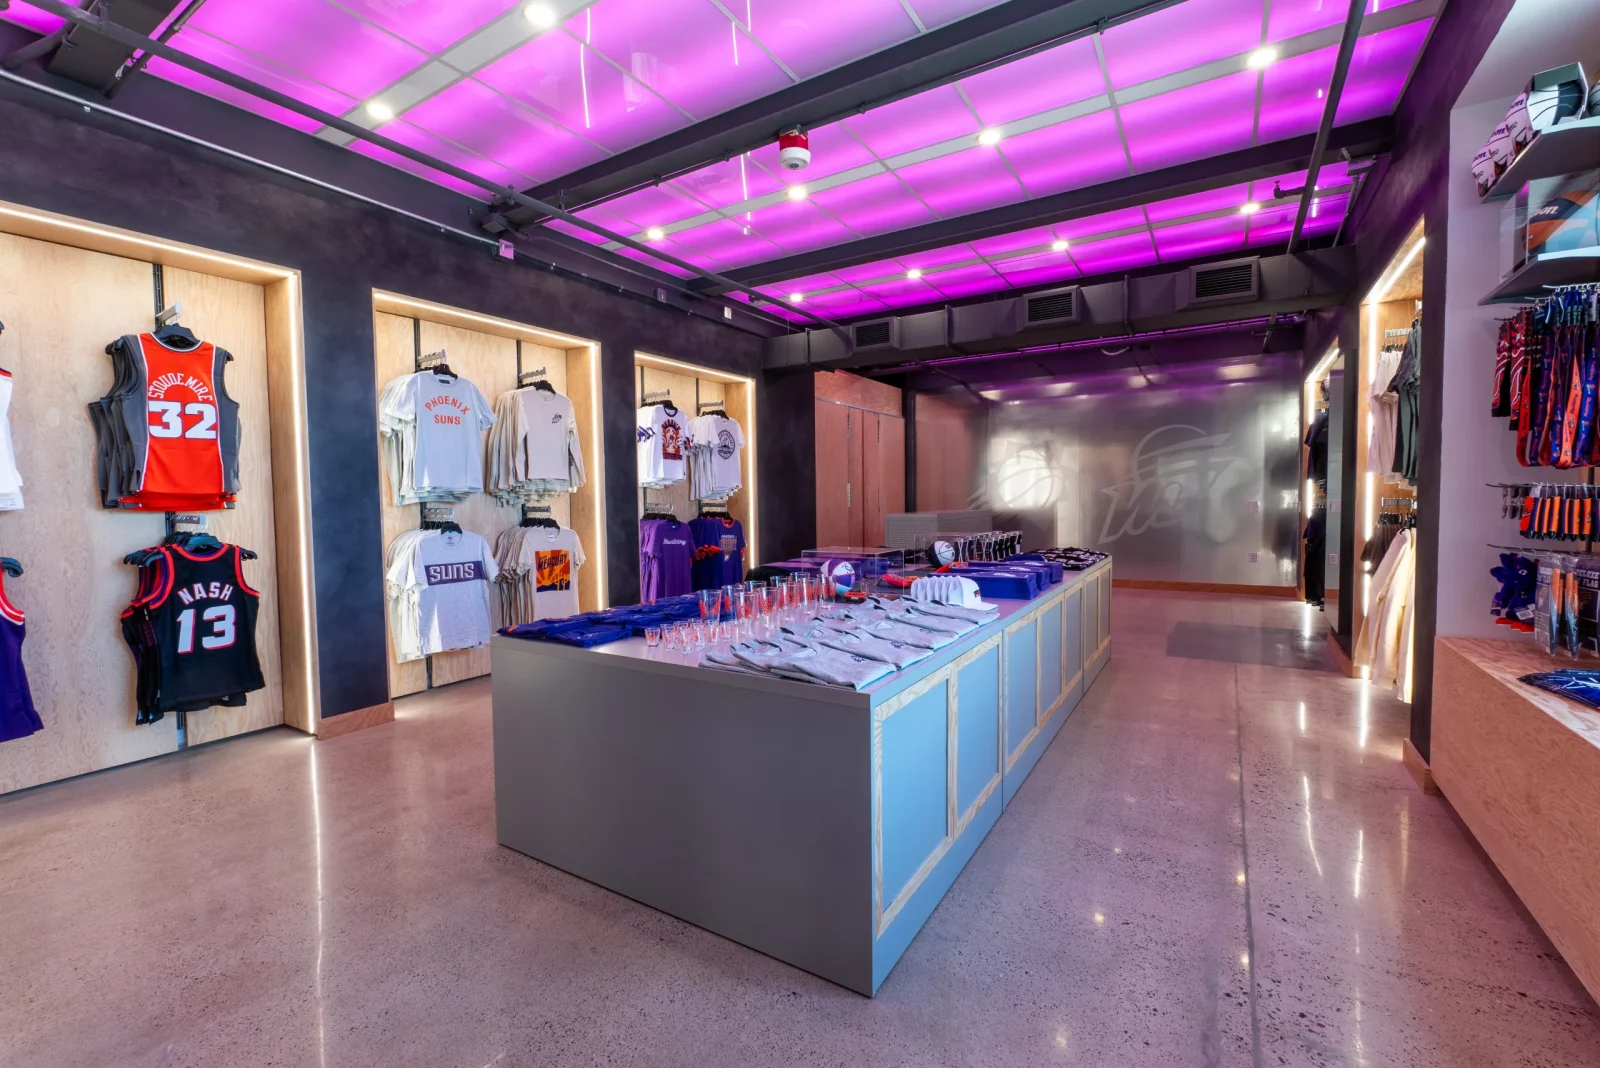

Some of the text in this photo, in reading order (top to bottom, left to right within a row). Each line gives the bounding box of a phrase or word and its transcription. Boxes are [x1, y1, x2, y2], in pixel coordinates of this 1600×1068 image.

[148, 372, 214, 402] STOUDEMIRE
[424, 395, 471, 415] PHOENIX
[148, 400, 217, 440] 32
[434, 414, 461, 426] SUNS
[429, 563, 475, 583] SUNS
[538, 553, 568, 571] MERCURY
[177, 581, 234, 606] NASH
[176, 604, 237, 655] 13
